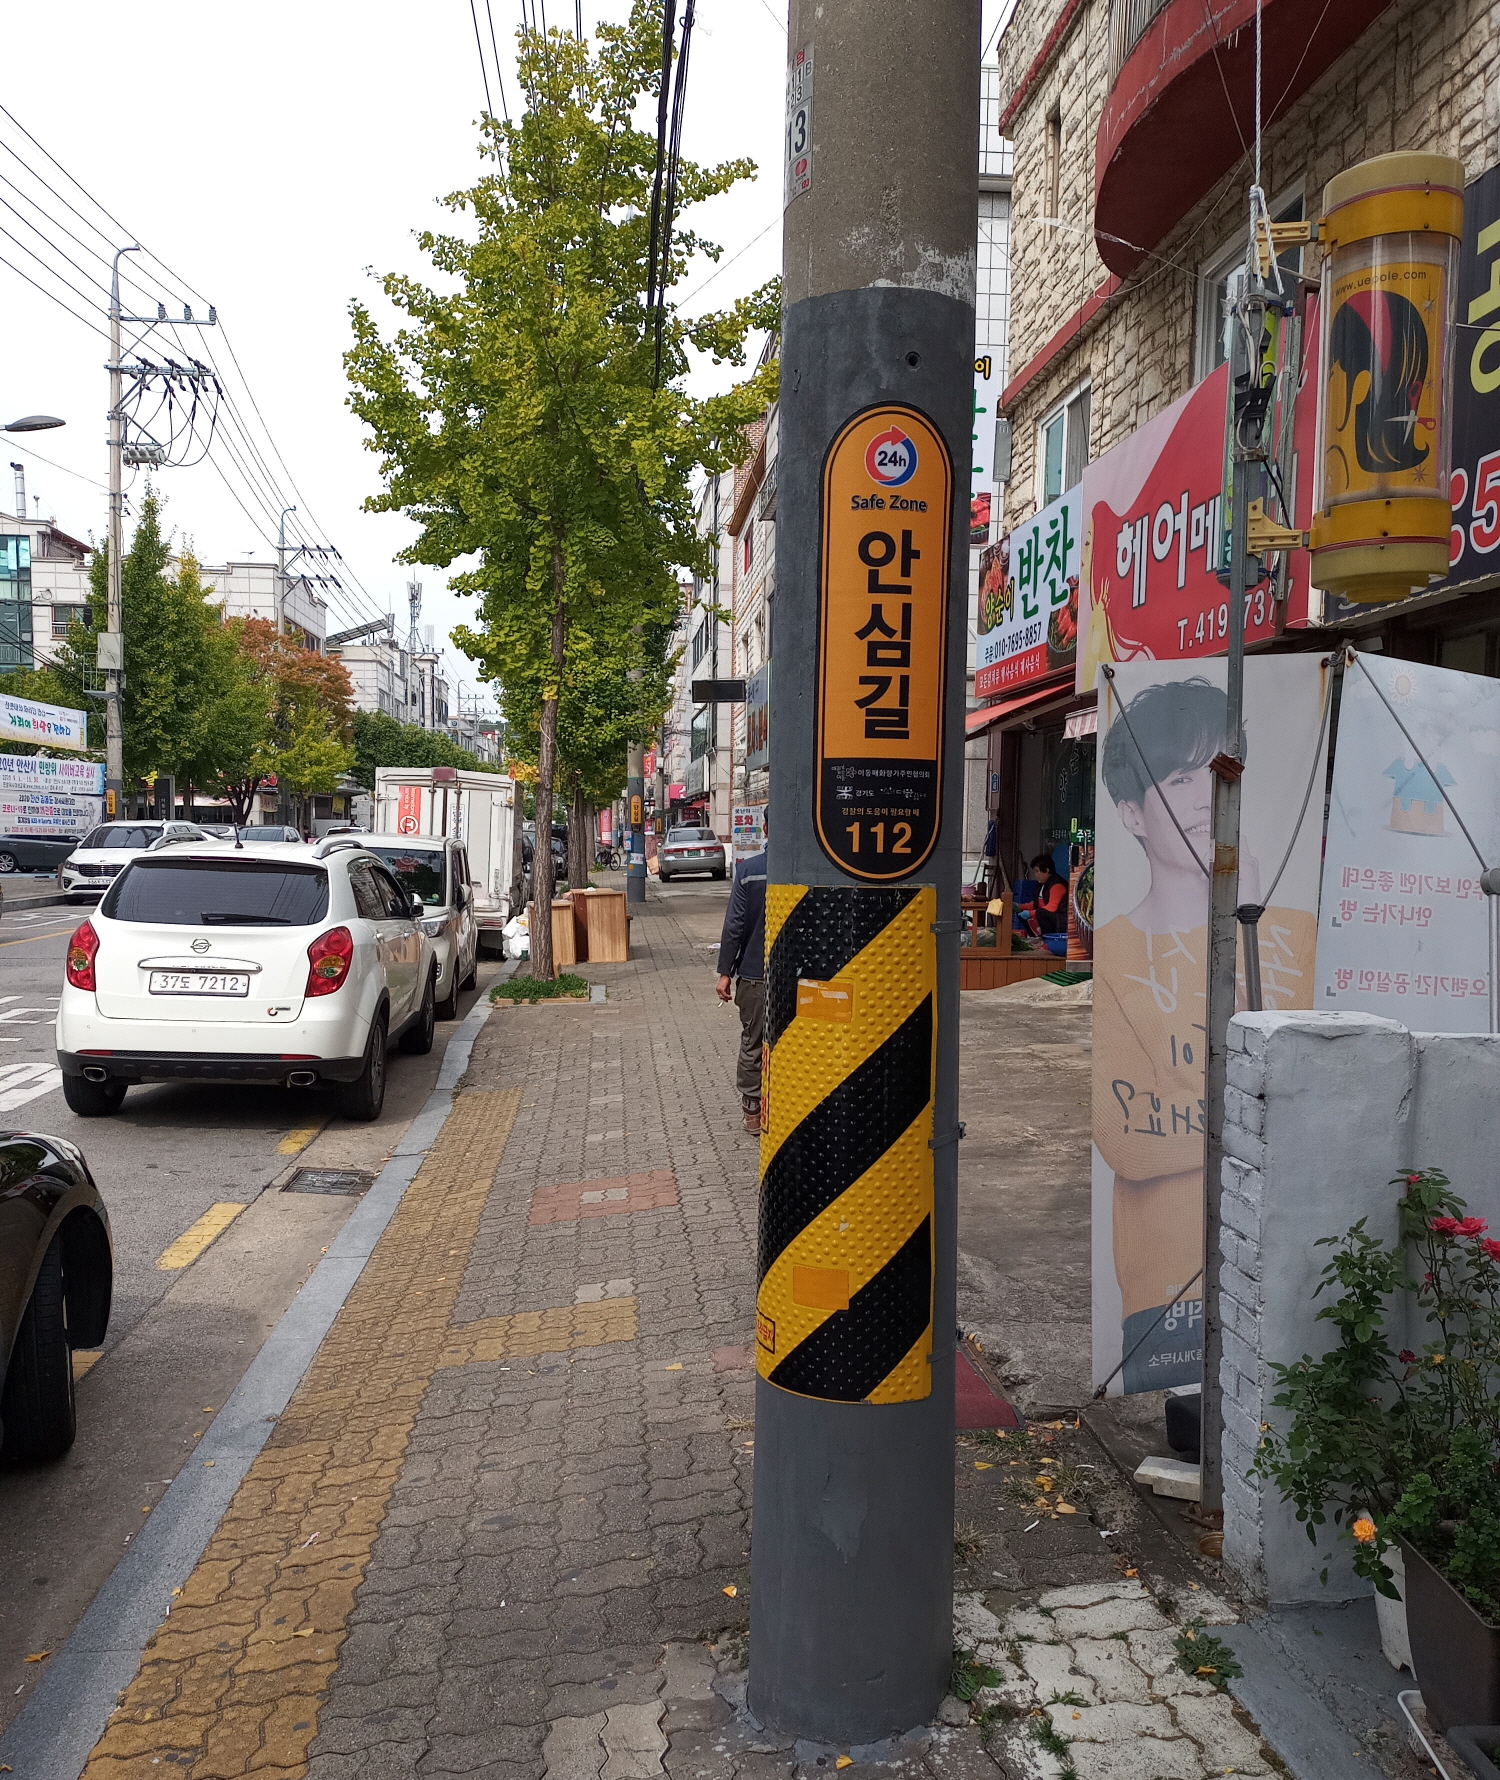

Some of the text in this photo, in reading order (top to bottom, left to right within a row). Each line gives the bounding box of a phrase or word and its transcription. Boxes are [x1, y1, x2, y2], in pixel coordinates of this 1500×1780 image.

[877, 450, 907, 469] 24h
[851, 493, 927, 513] Safe Zone
[1017, 505, 1074, 620] 반찬
[986, 577, 1015, 629] 양순이
[854, 529, 920, 740] 안심길
[979, 667, 1000, 689] 모든김치류
[1020, 652, 1040, 676] 제사음식
[16, 758, 37, 774] 안산시
[39, 760, 57, 776] 민방위
[855, 789, 875, 797] 경기도
[842, 807, 920, 817] 경찰의 도움이 필요할 때
[846, 821, 912, 854] 112
[159, 975, 239, 991] 37도 7212
